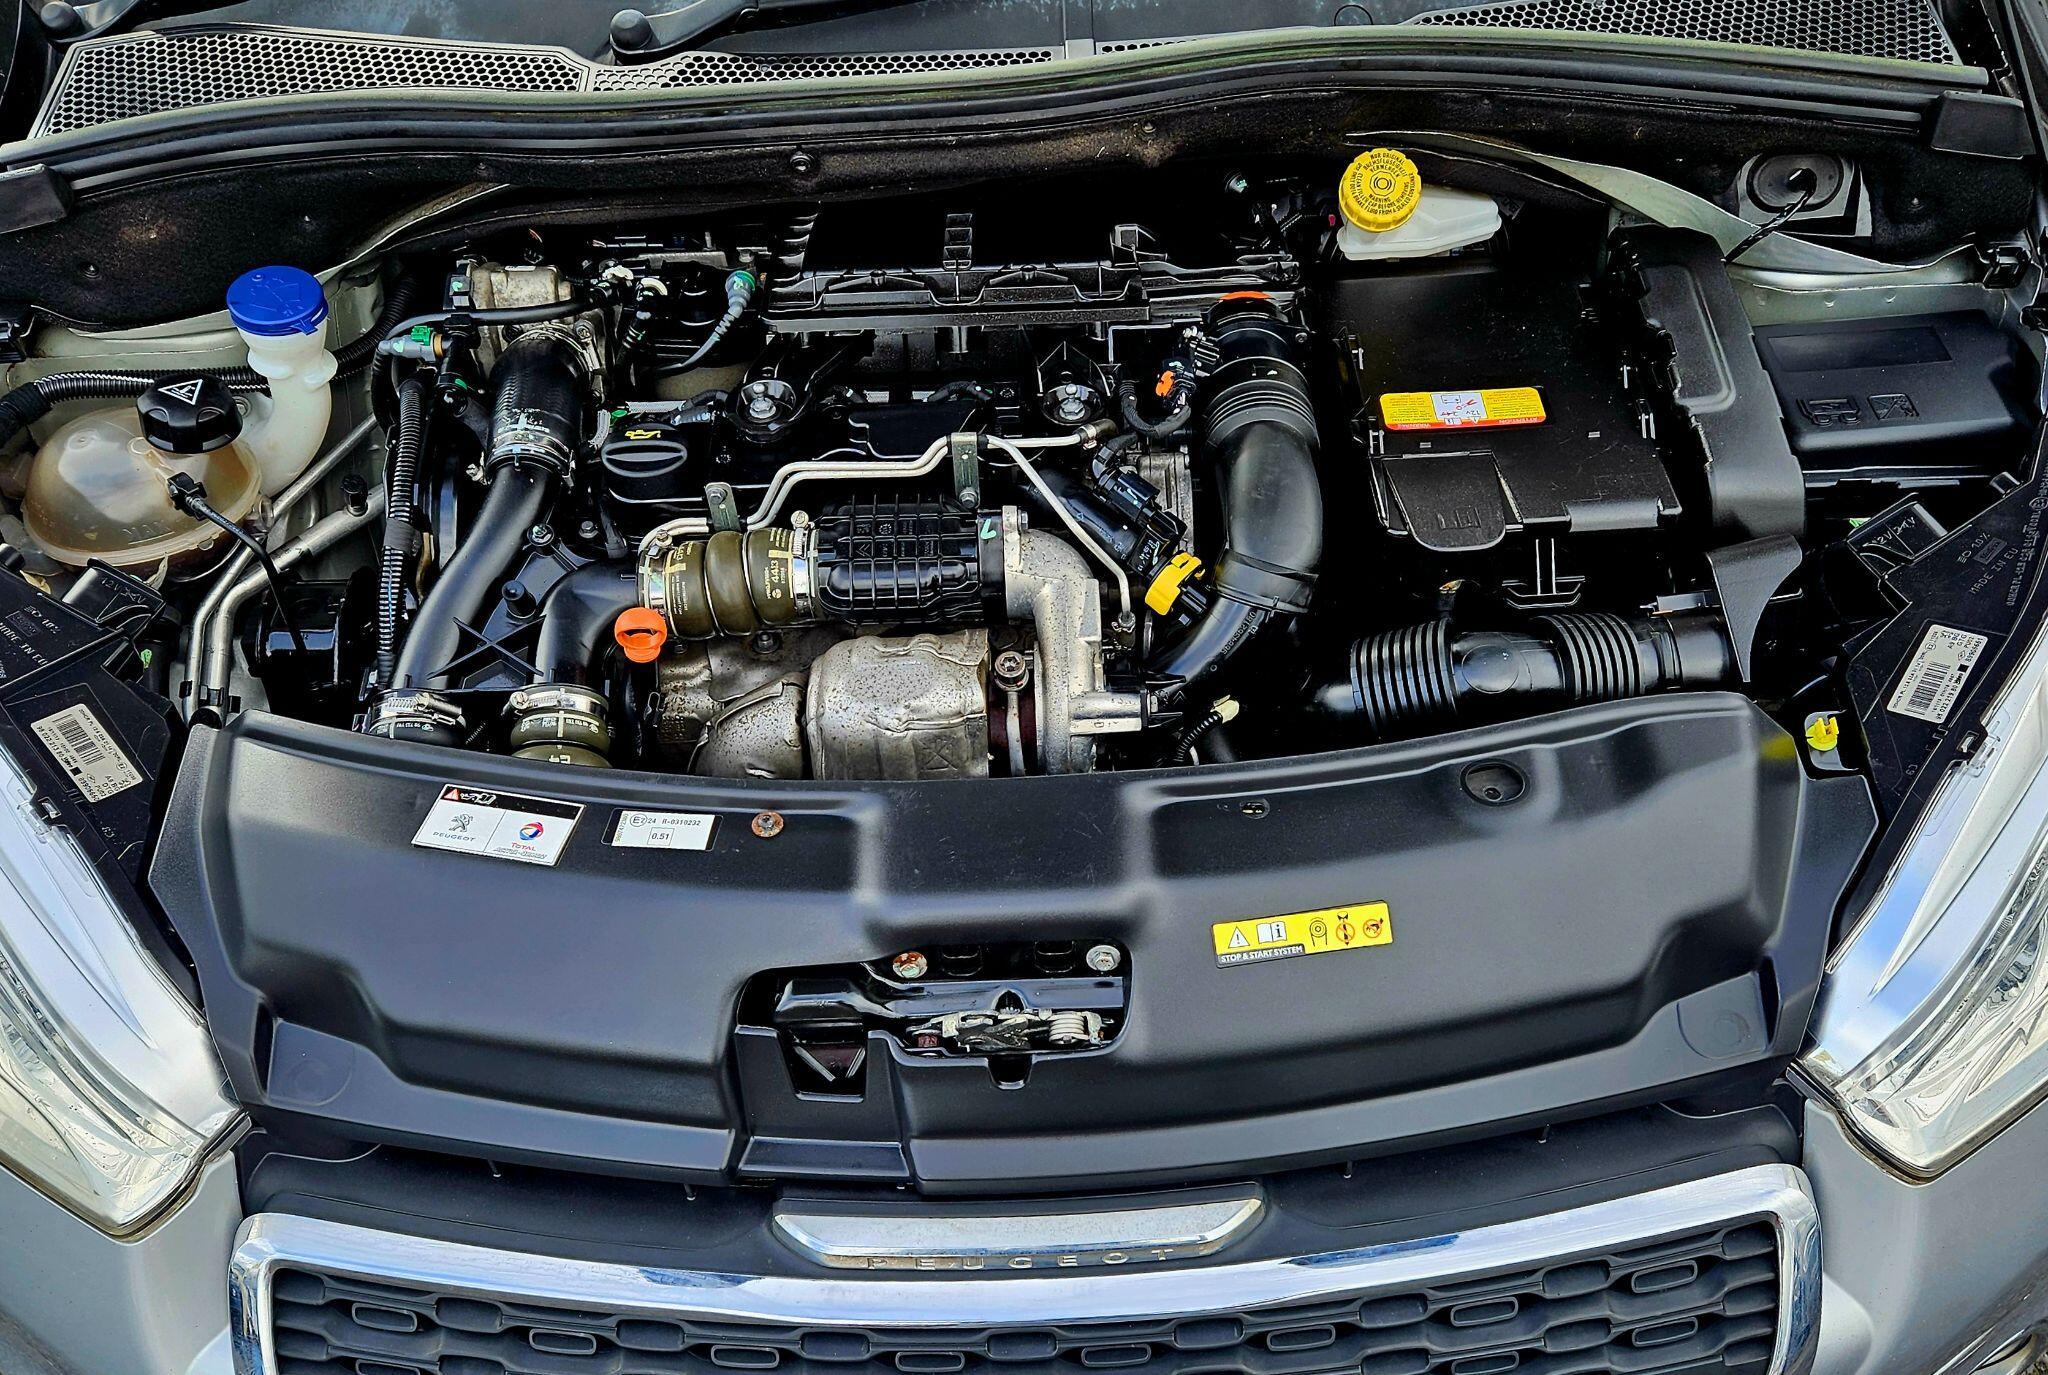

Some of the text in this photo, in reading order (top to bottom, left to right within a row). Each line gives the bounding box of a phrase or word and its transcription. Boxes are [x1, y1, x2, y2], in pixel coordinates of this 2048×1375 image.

[1969, 572, 1994, 595] MADE
[1991, 560, 2006, 573] IN
[2004, 548, 2018, 560] EU
[432, 831, 477, 842] PEUGEOT
[651, 832, 670, 840] 0.51
[511, 842, 536, 851] TOTAL
[1221, 953, 1241, 963] STOP
[1249, 949, 1275, 960] START
[1275, 945, 1303, 957] SYSTEM
[866, 1248, 1175, 1270] PEUGEOT
